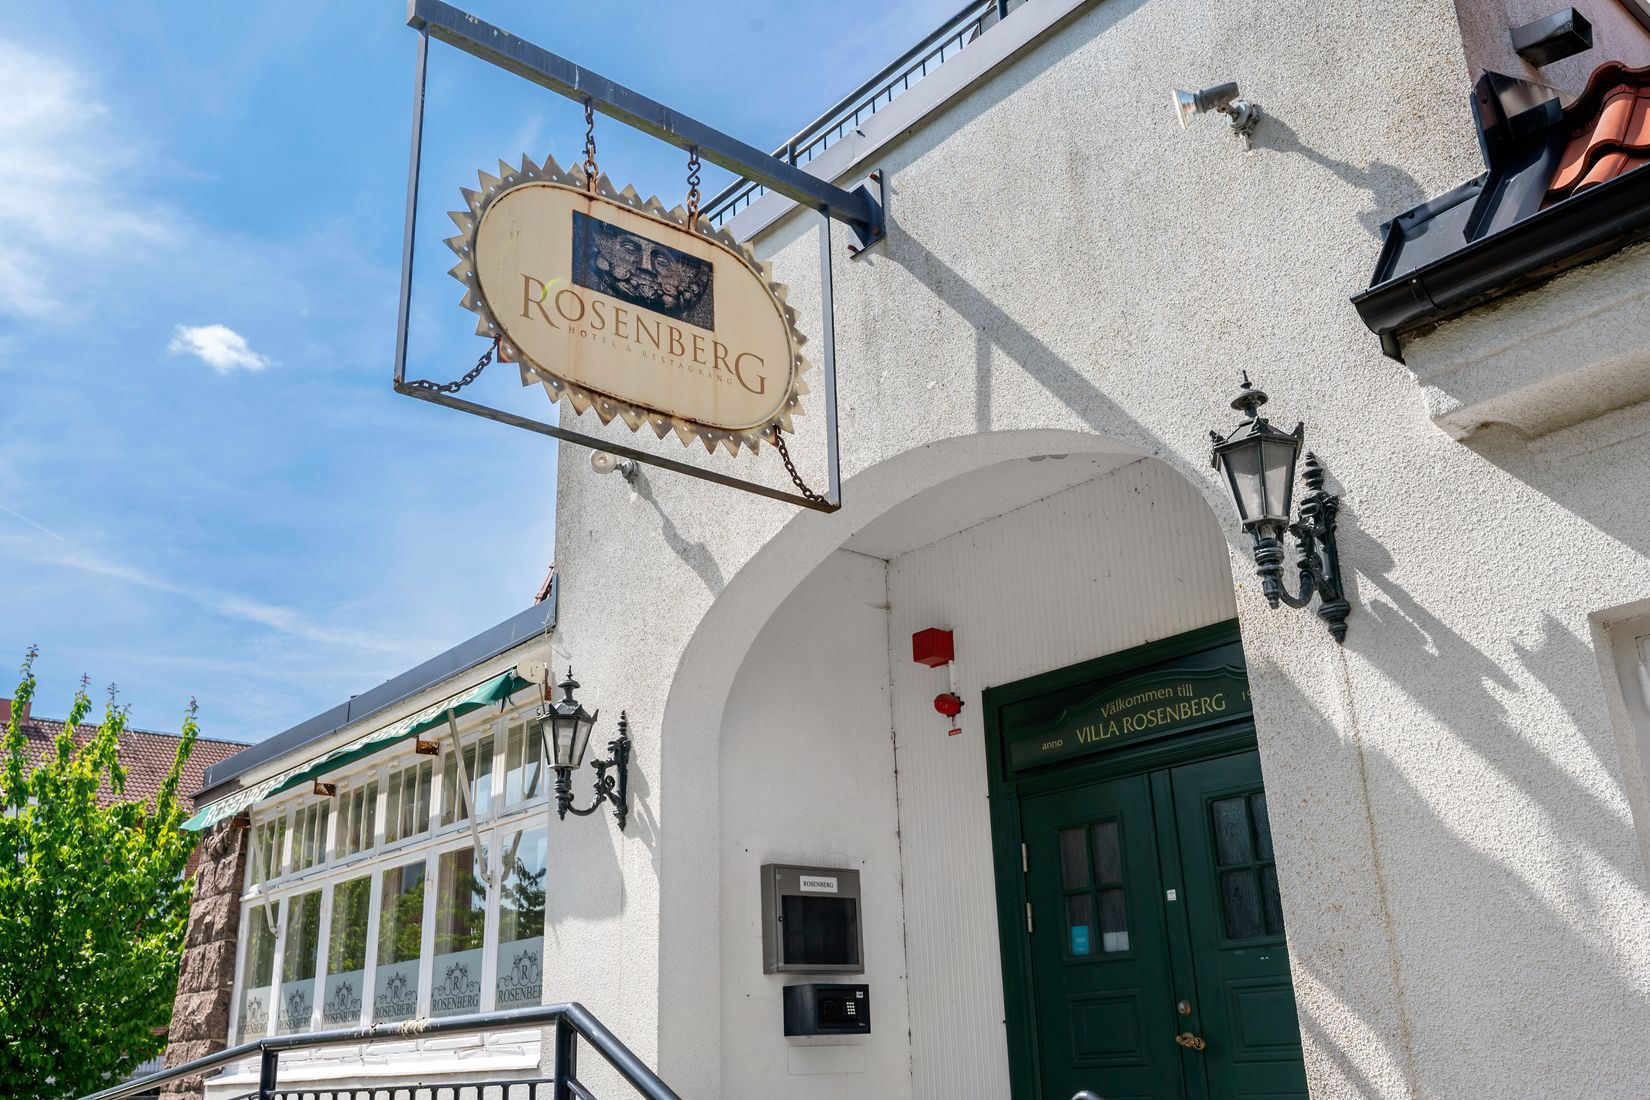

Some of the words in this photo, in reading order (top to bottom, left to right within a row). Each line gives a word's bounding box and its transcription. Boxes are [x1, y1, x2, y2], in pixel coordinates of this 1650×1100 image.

[520, 272, 767, 395] ROSENBERG
[568, 326, 617, 348] HOTEL
[626, 345, 633, 353] &
[642, 351, 733, 385] RESTAURANG
[1101, 687, 1173, 718] Välkommen
[1177, 684, 1194, 698] till
[1076, 721, 1120, 744] VILLA
[1123, 693, 1226, 734] ROSENBERG
[1041, 738, 1064, 751] anno
[521, 965, 529, 980] R
[393, 985, 400, 999] R
[452, 976, 460, 991] R
[432, 994, 479, 1012] ROSENBERG
[498, 984, 542, 1004] ROSENBER
[322, 1009, 361, 1026] ROSENBERG
[374, 1001, 417, 1020] ROSENBERG
